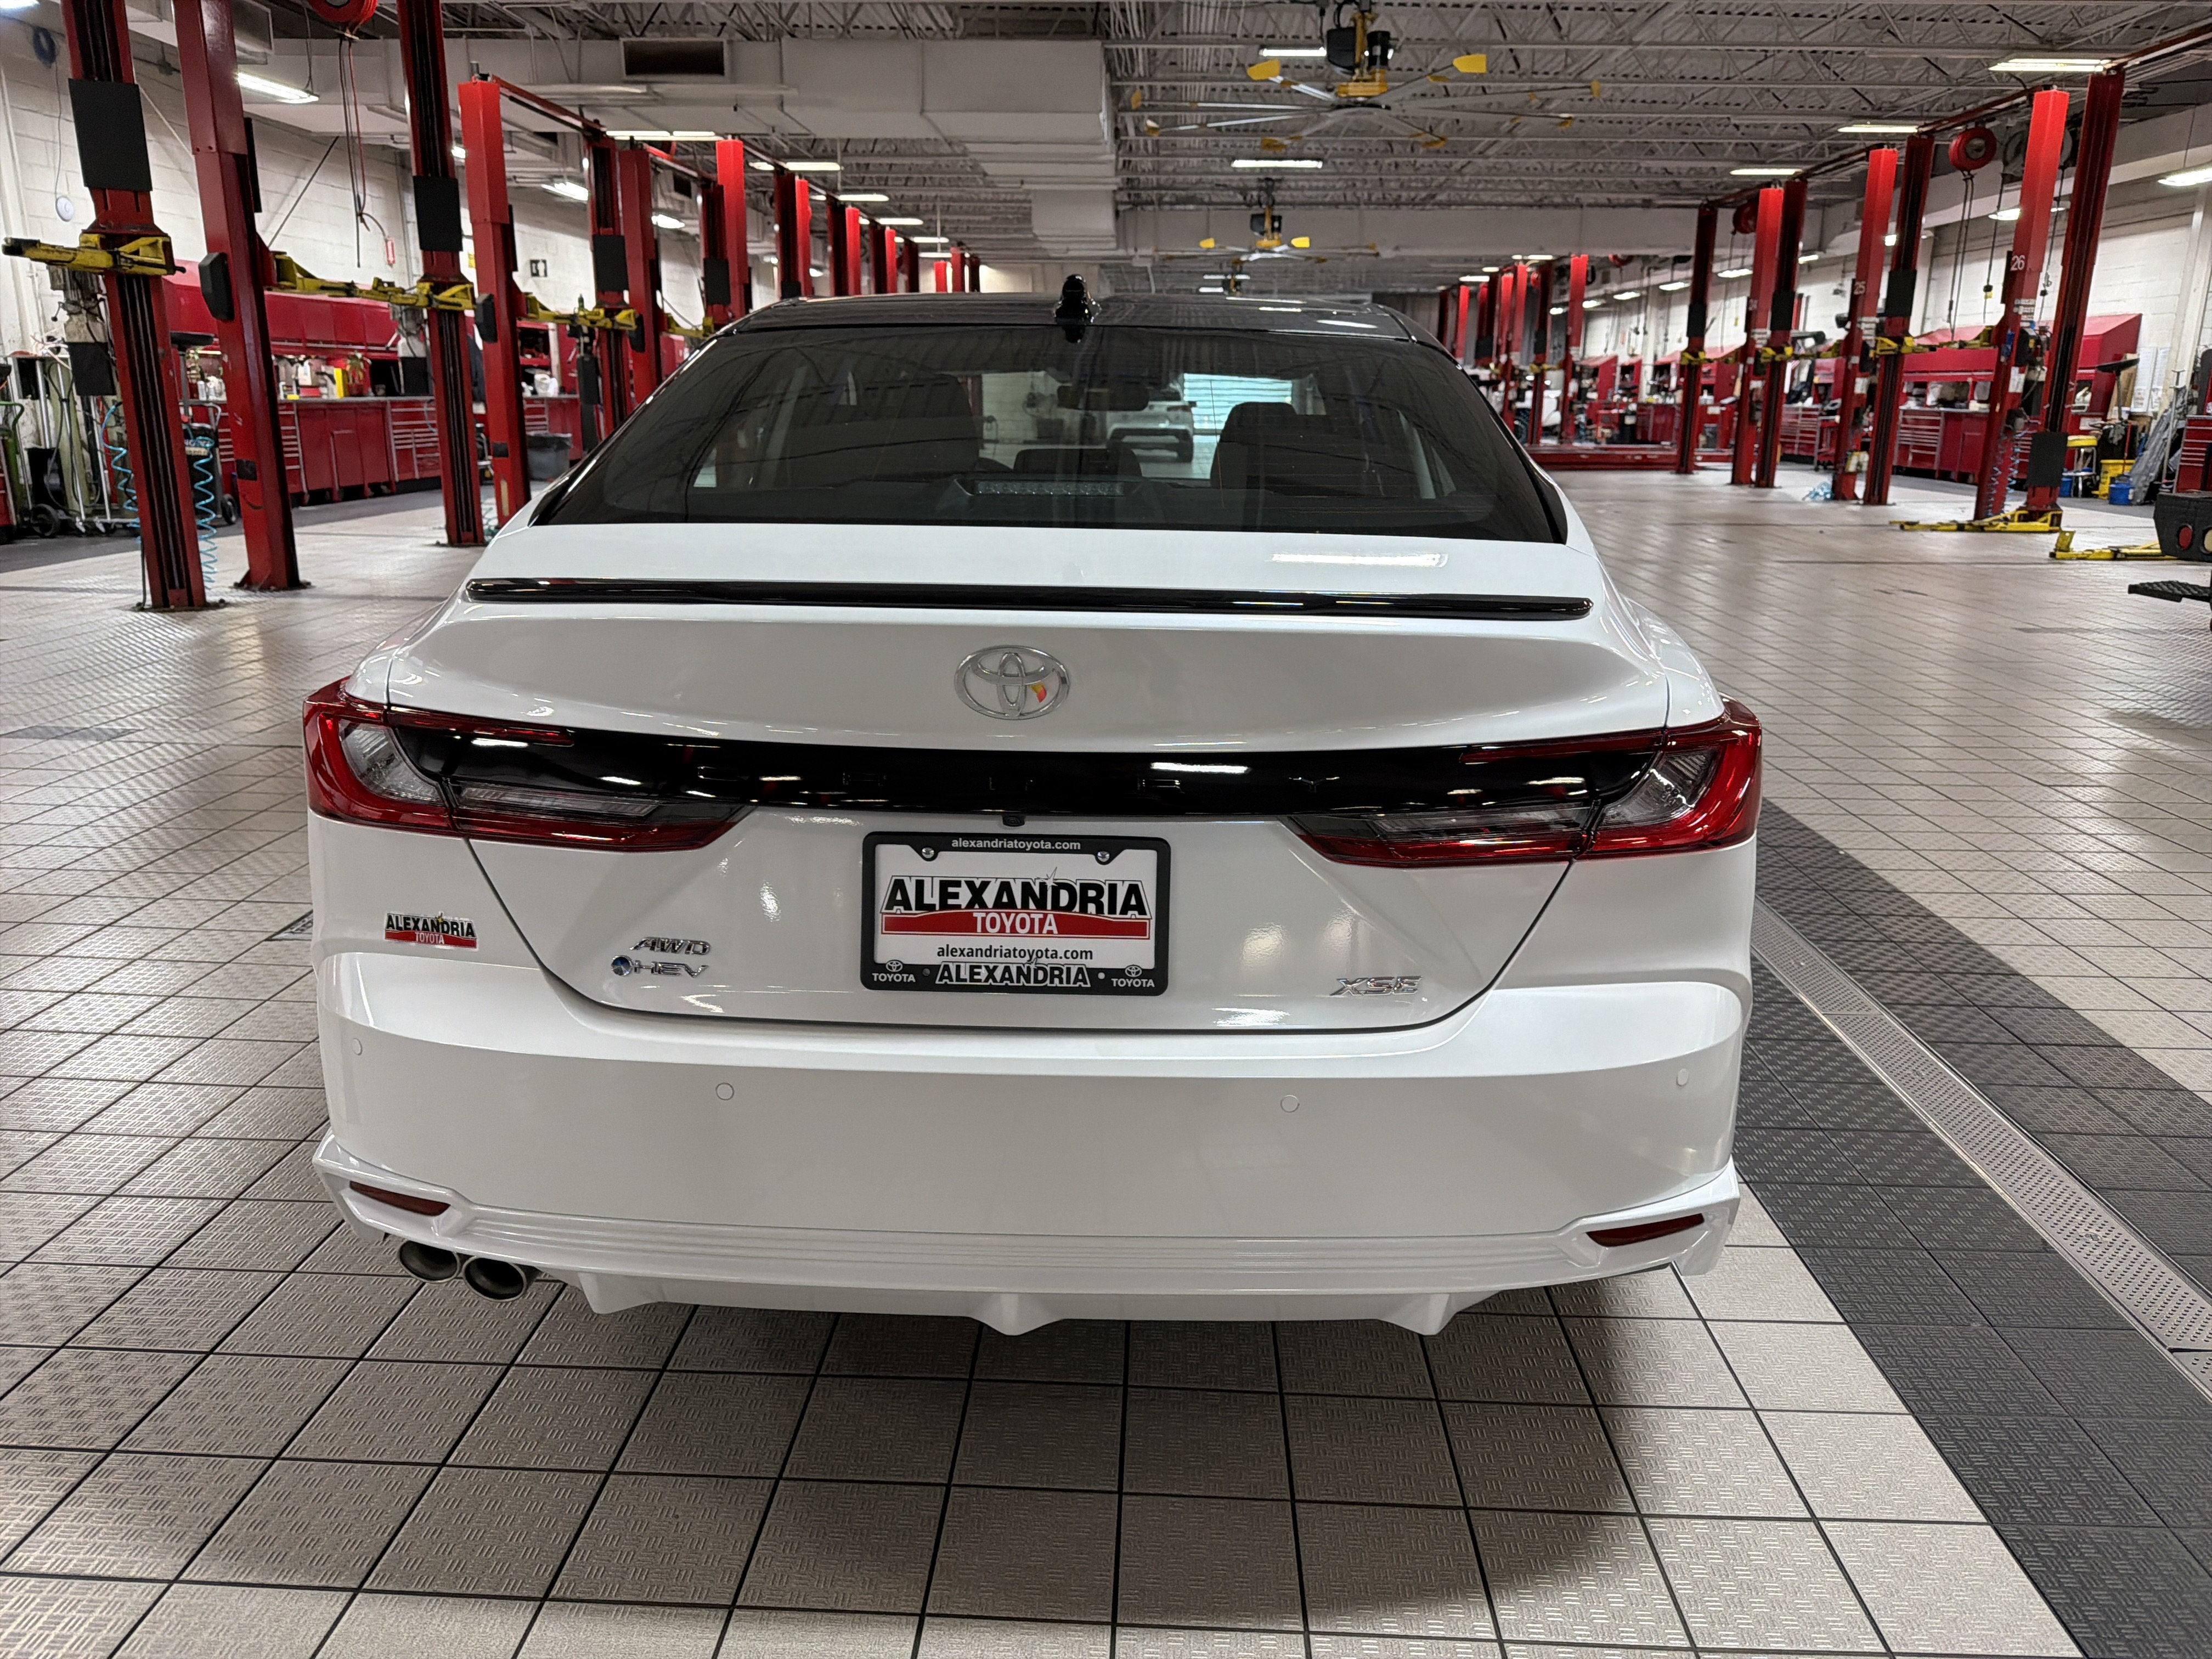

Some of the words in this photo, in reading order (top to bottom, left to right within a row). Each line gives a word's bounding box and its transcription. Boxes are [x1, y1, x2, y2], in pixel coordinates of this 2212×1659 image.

[2010, 255, 2025, 271] 26
[1854, 281, 1866, 295] 25
[951, 837, 1081, 851] alexandriatoyota.com
[883, 878, 1150, 917] ALEXANDRIA
[386, 914, 475, 938] ALEXANDRIA
[973, 912, 1058, 935] TOYOTA
[415, 932, 445, 944] TOYOTA
[630, 937, 710, 955] AWD
[936, 944, 1093, 961] alexandriatoyota.com
[872, 973, 916, 983] TOYOTA
[936, 962, 1090, 987] ALEXANDRIA
[1111, 978, 1155, 988] TOYOTA
[1330, 976, 1423, 997] XSE
